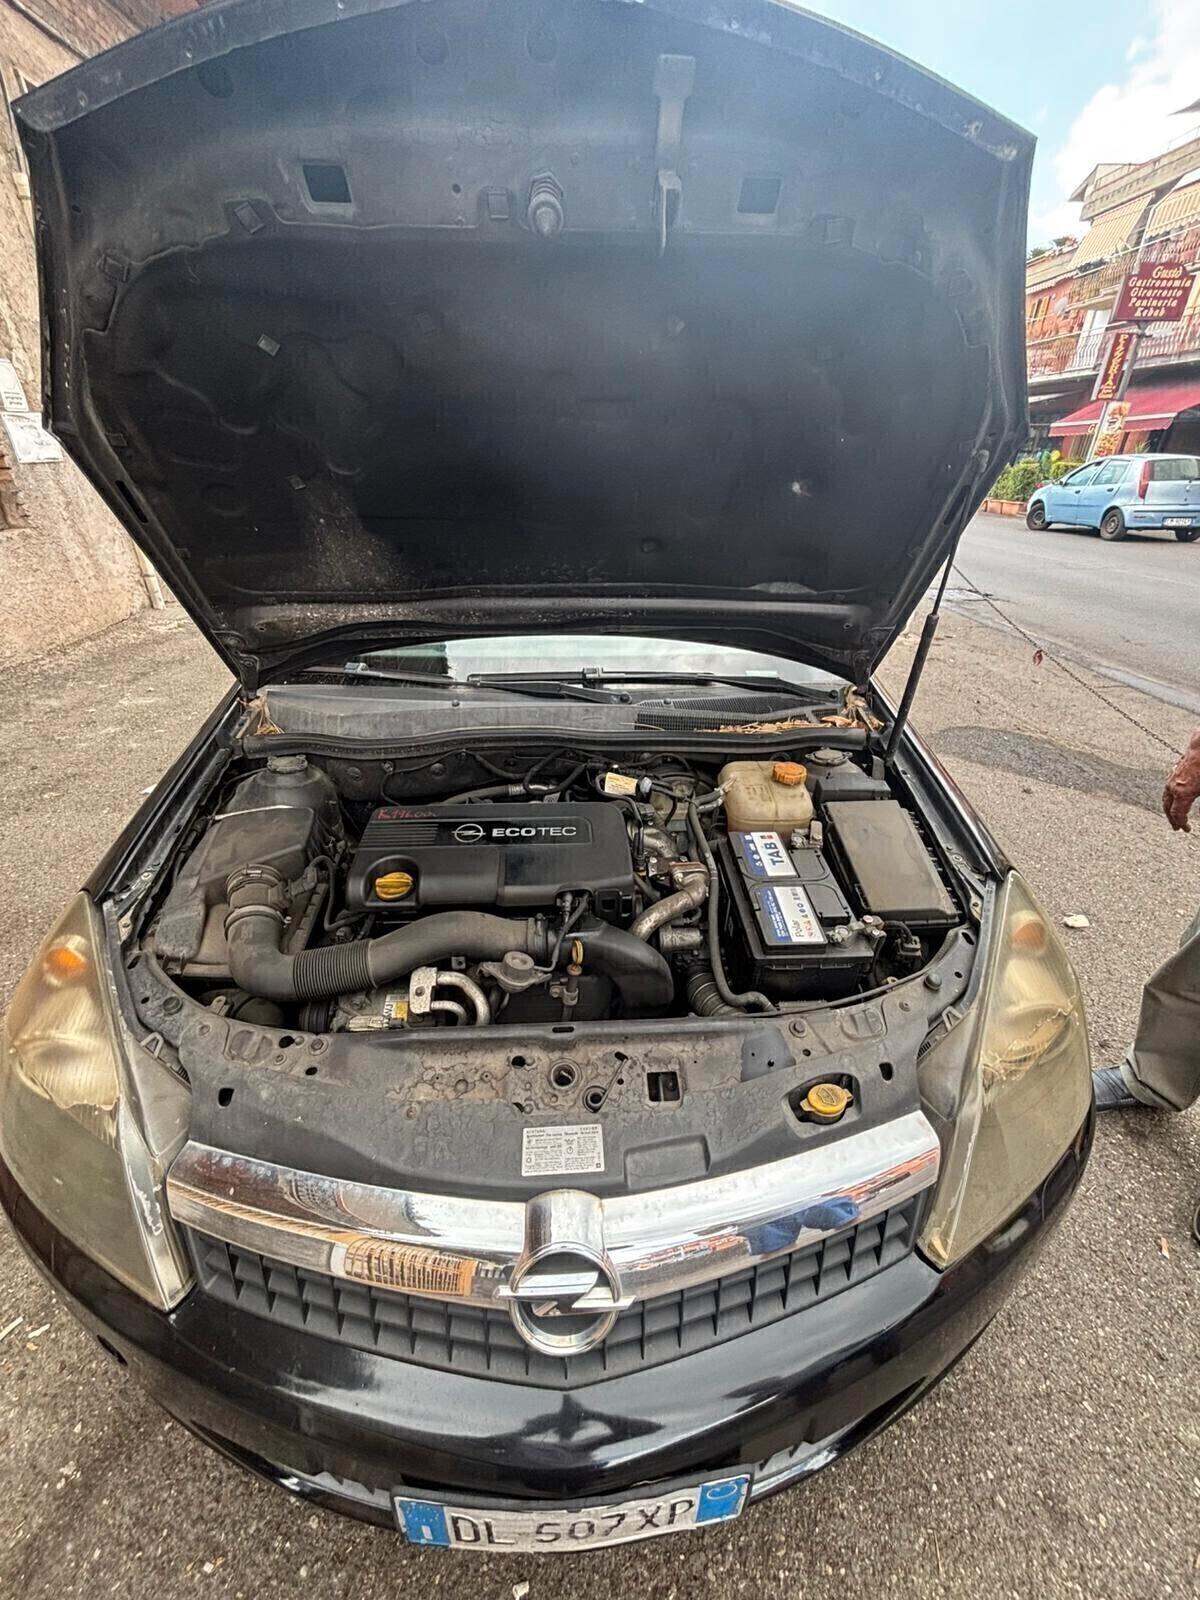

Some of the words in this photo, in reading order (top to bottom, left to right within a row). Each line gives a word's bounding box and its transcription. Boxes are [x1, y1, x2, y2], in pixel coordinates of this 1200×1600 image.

[1128, 277, 1192, 287] Gastronomia
[1130, 287, 1183, 298] Girarrosto
[1134, 307, 1166, 317] Kebab
[1105, 334, 1129, 385] PIZZERIA
[492, 826, 577, 838] ECOTEC
[764, 842, 785, 866] TAB
[450, 1514, 515, 1546] DL
